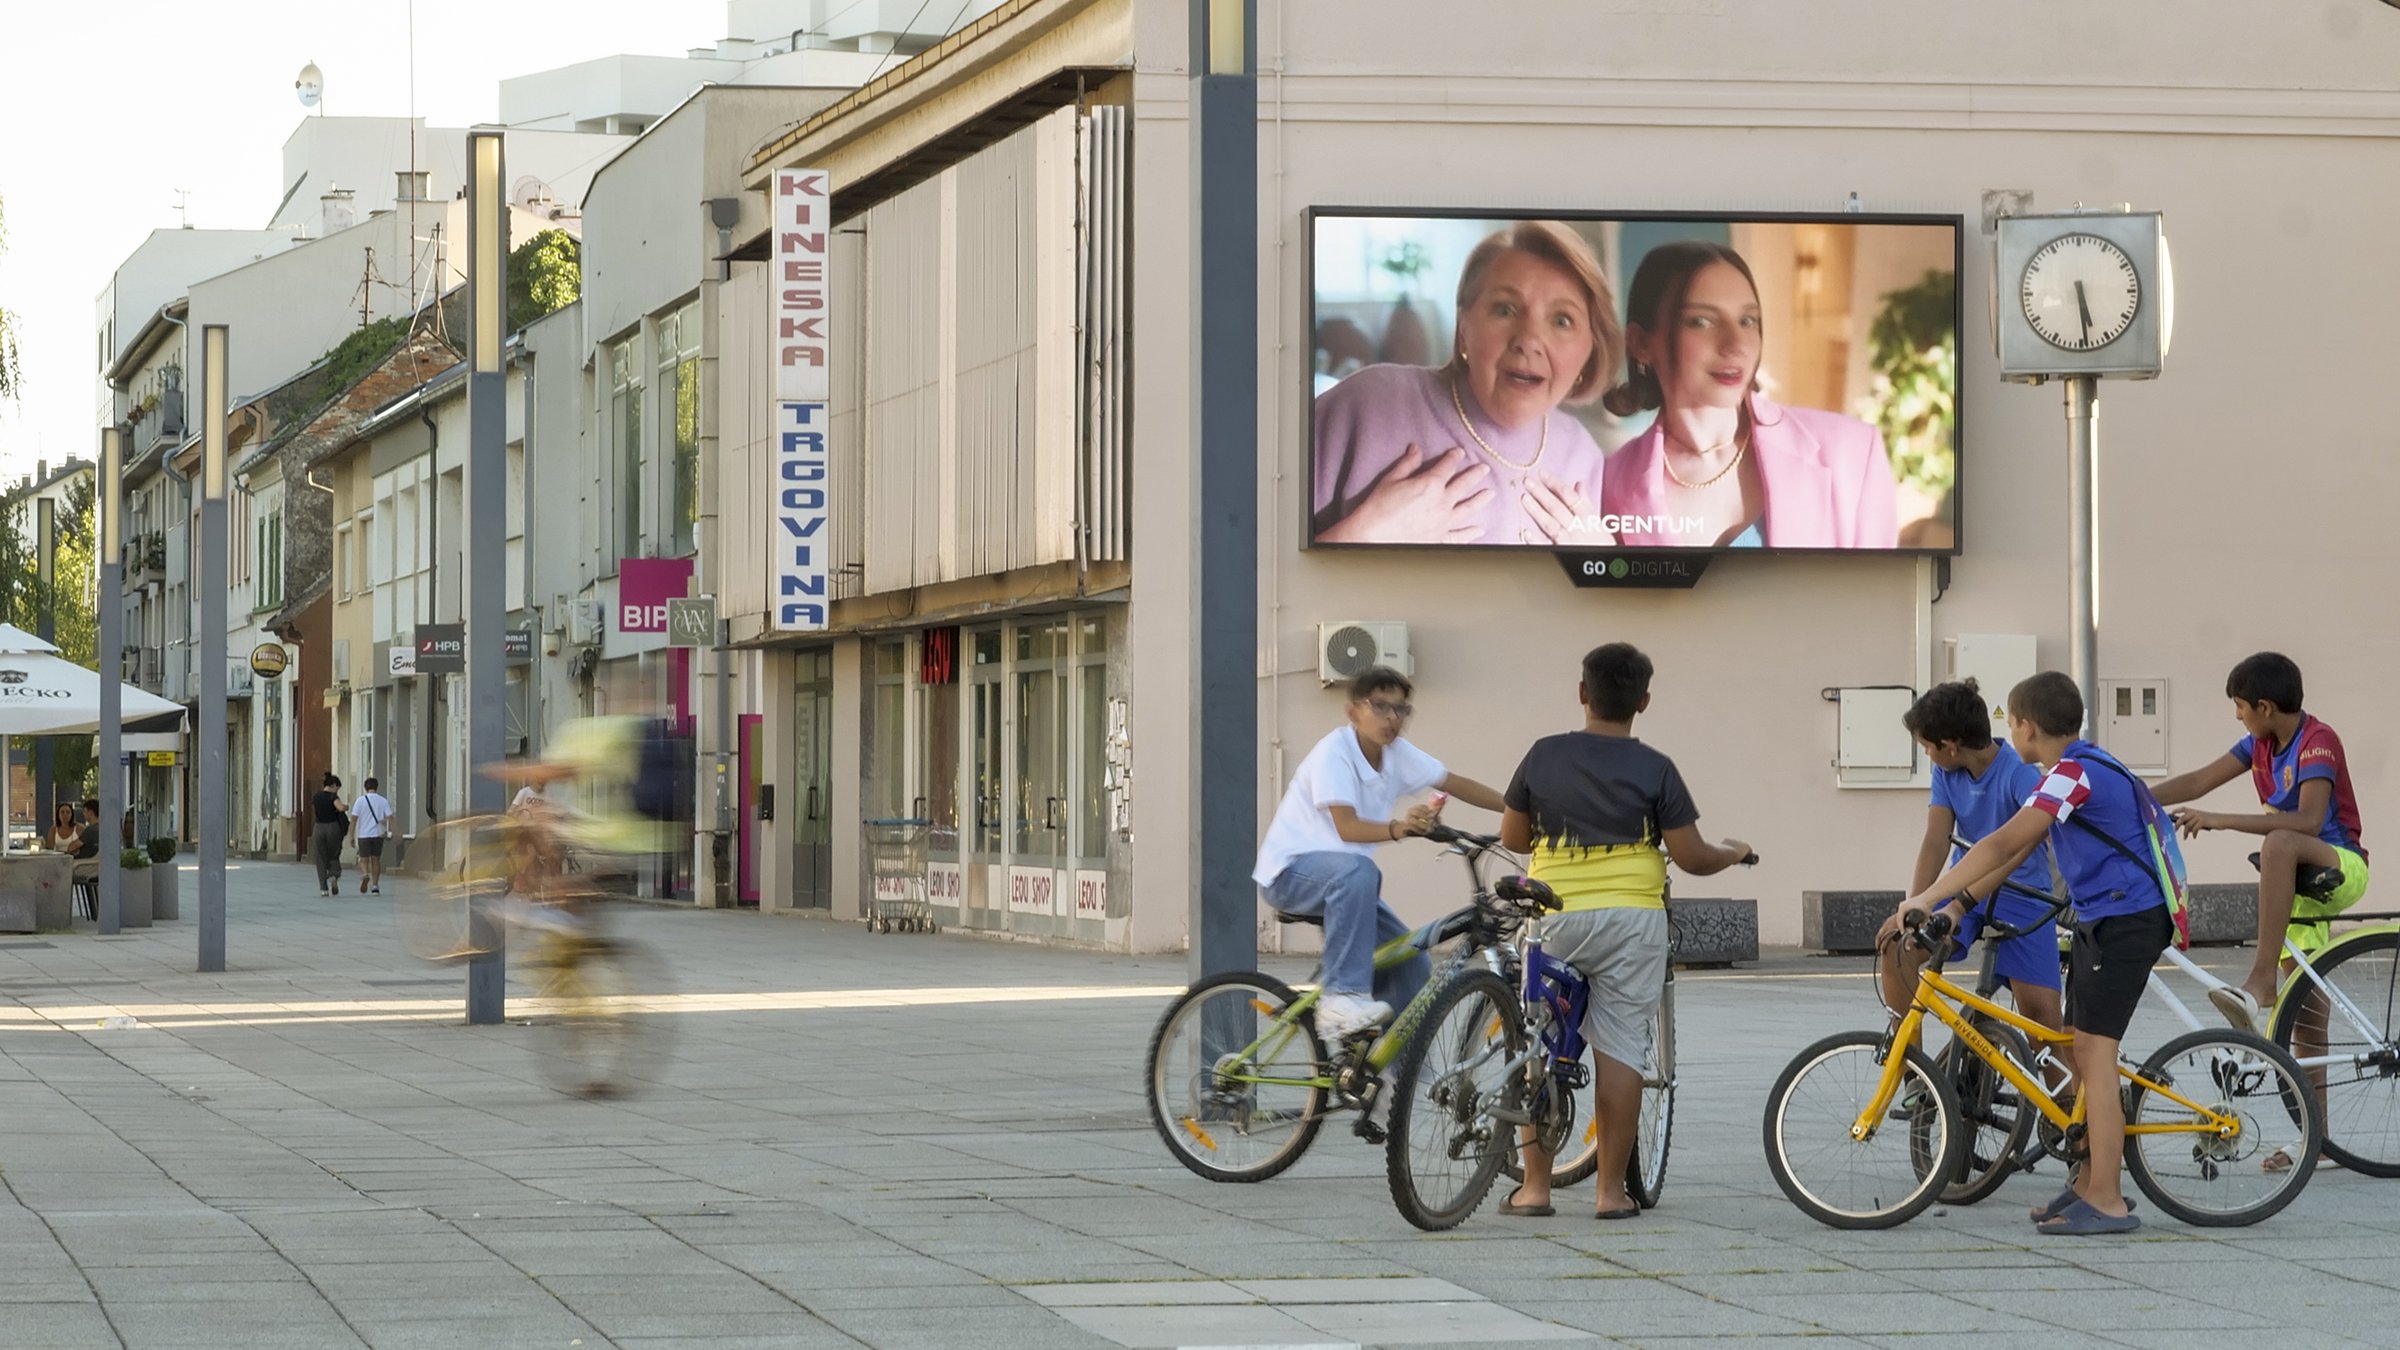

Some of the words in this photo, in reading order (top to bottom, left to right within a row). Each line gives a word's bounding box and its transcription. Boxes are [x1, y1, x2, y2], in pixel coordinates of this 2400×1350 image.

[780, 175, 826, 367] KINESKA
[779, 403, 827, 624] TRGOVINA
[1567, 514, 1704, 534] ARGENTUM
[1583, 560, 1607, 576] GO
[1631, 561, 1690, 577] DIGITAL
[434, 640, 461, 652] HPB
[1011, 874, 1029, 904] LEOU
[1032, 876, 1051, 908] SHOP
[1078, 879, 1097, 911] LEOU
[1953, 1019, 1993, 1058] RIVERSIDE
